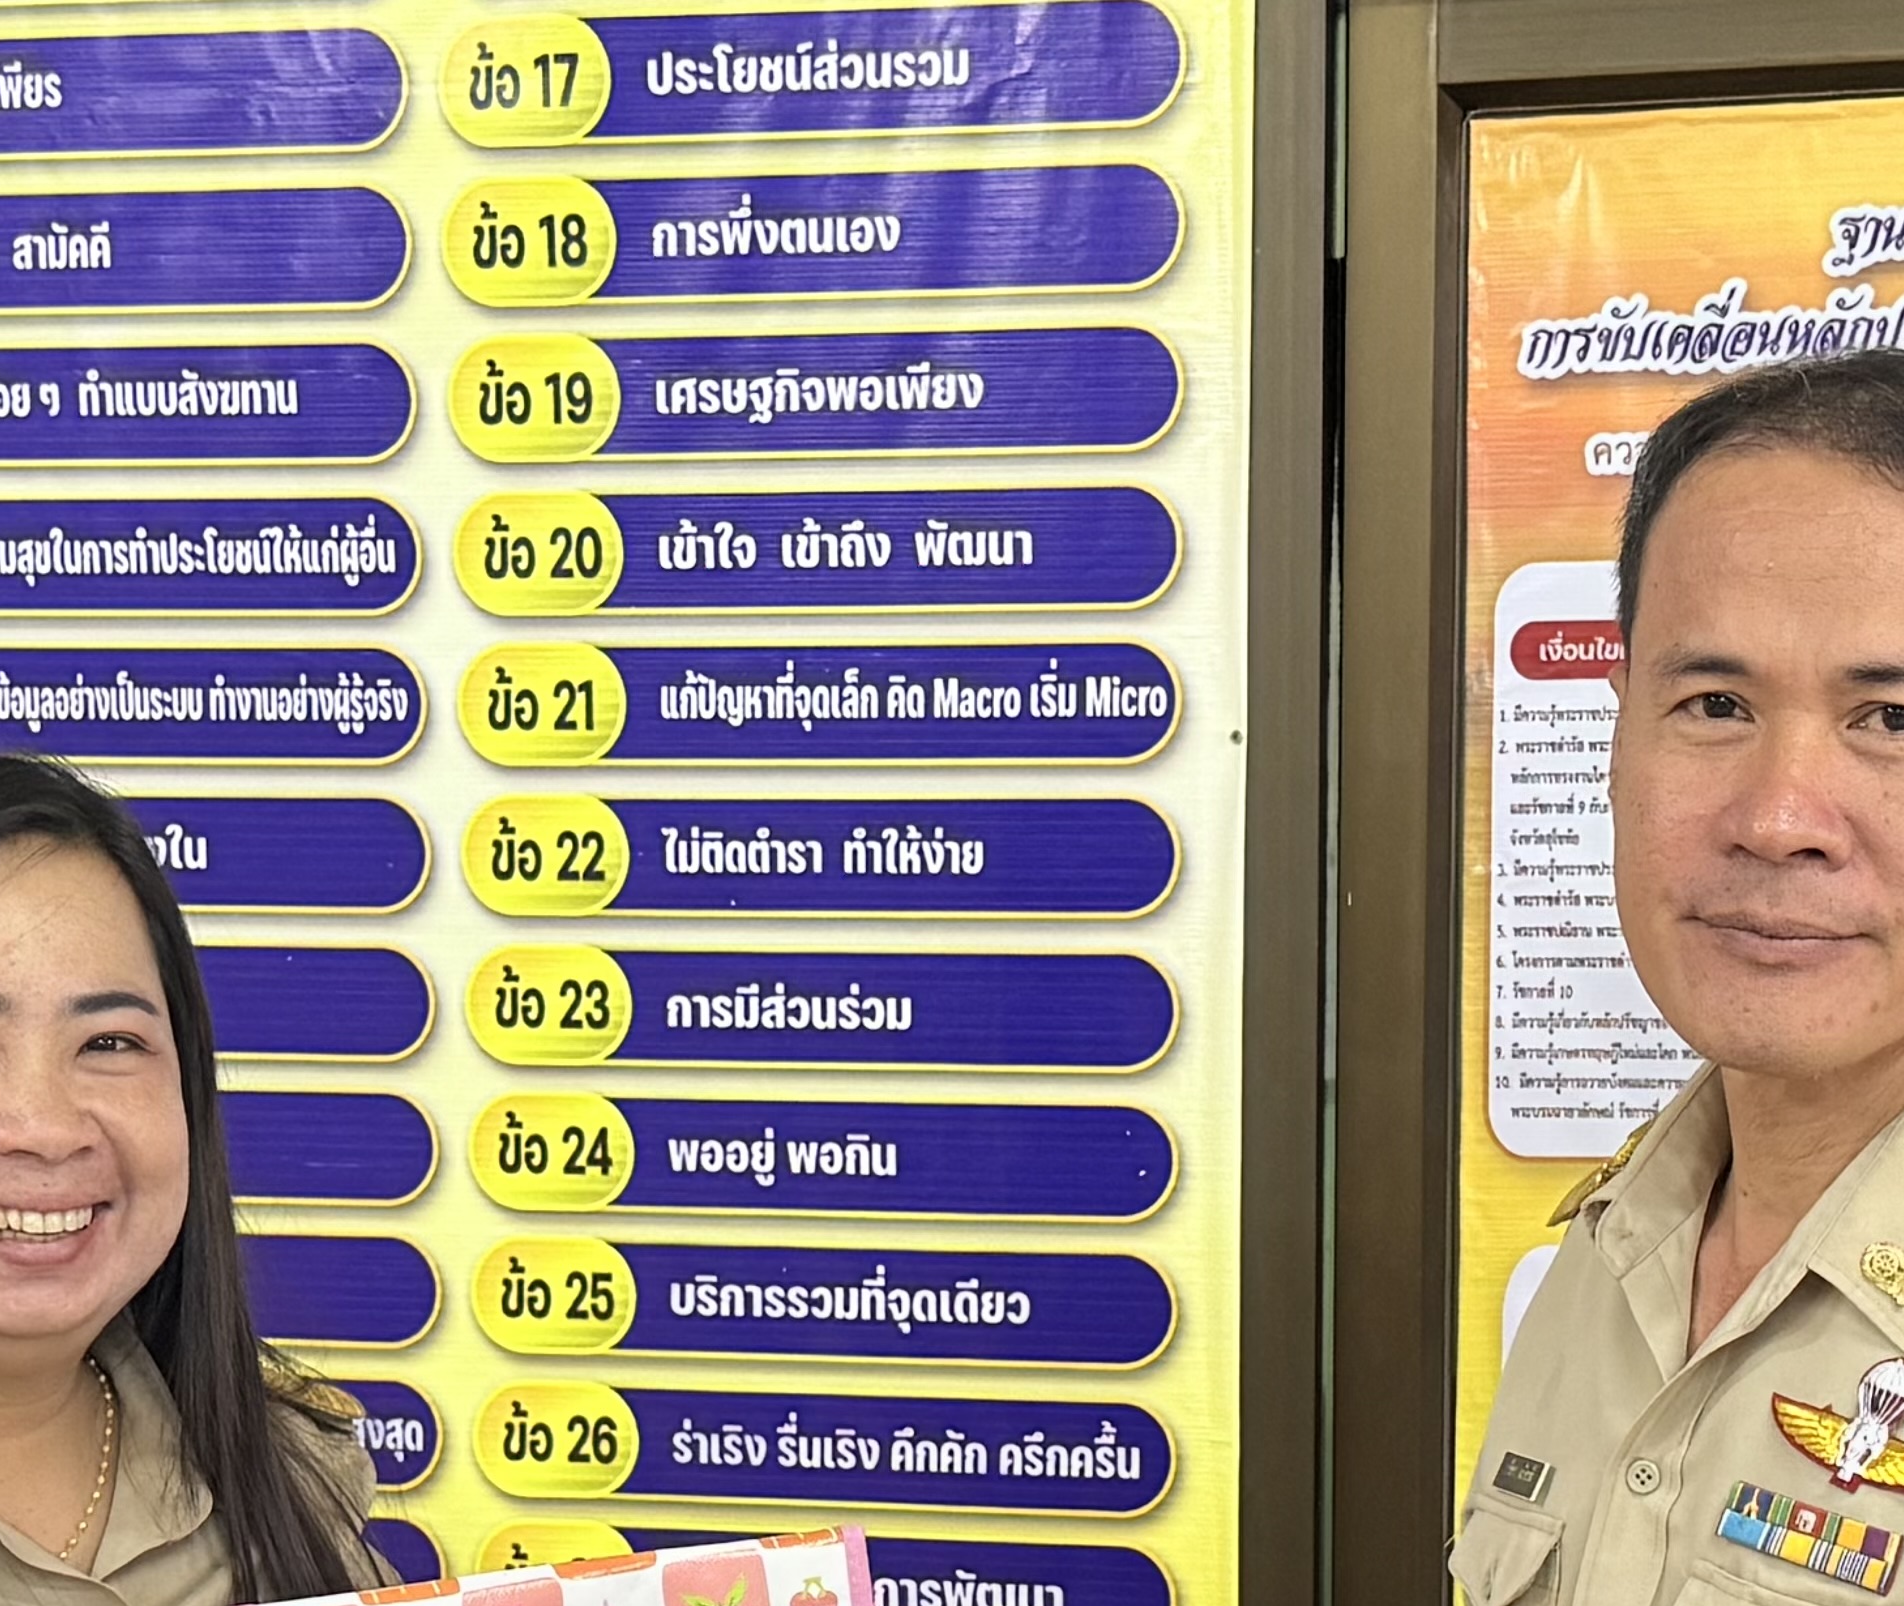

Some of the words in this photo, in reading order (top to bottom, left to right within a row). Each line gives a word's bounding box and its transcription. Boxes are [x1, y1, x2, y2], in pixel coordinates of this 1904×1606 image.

[470, 41, 521, 110] ข้อ
[534, 54, 580, 108] 17
[646, 38, 970, 98] ประโยชน์ส่วนรวม
[12, 222, 112, 271] สามัคคี
[472, 201, 526, 269] ข้อ
[538, 215, 588, 265] 18
[652, 194, 901, 256] การพึ่งตนเอง
[78, 369, 298, 417] ทำแบบสังฆทาน
[478, 359, 531, 426] ข้อ
[545, 372, 594, 424] 19
[655, 361, 984, 425] เศรษฐกิจพอเพียง
[485, 514, 536, 580] ข้อ
[550, 526, 602, 579] 20
[658, 519, 757, 571] เข้าใจ
[781, 516, 892, 570] เข้าถึง
[914, 519, 1034, 568] พัฒนา
[209, 672, 409, 736] ทำงานอย่างผู้รู้จริง
[487, 666, 540, 732] ข้อ
[554, 680, 596, 731] 21
[660, 659, 878, 732] แก้ปัญหาที่จุดเล็ก
[886, 675, 926, 720] คิด
[932, 679, 1021, 720] Macro
[1028, 658, 1078, 720] เริ่ม
[1085, 676, 1167, 719] Micro
[491, 816, 544, 884] ข้อ
[556, 831, 606, 882] 22
[661, 826, 824, 876] ไม่ติดตำรา
[844, 826, 984, 876] ทำให้ง่าย
[495, 965, 546, 1032] ข้อ
[559, 981, 611, 1030] 23
[667, 982, 914, 1033] การมีส่วนร่วม
[1560, 985, 1573, 998] 10
[498, 1112, 549, 1177] ข้อ
[562, 1126, 613, 1176] 24
[668, 1129, 776, 1187] พออยู่
[787, 1131, 898, 1177] พอกิน
[501, 1257, 552, 1323] ข้อ
[565, 1272, 616, 1321] 25
[670, 1264, 1031, 1336] บริการรวมที่จุดเดียว
[504, 1400, 555, 1467] ข้อ
[568, 1417, 619, 1465] 26
[672, 1416, 767, 1467] ร่าเริง
[777, 1414, 880, 1471] รื่นเริง
[890, 1426, 988, 1475] คึกคัก
[998, 1419, 1142, 1481] ครึกครื้น
